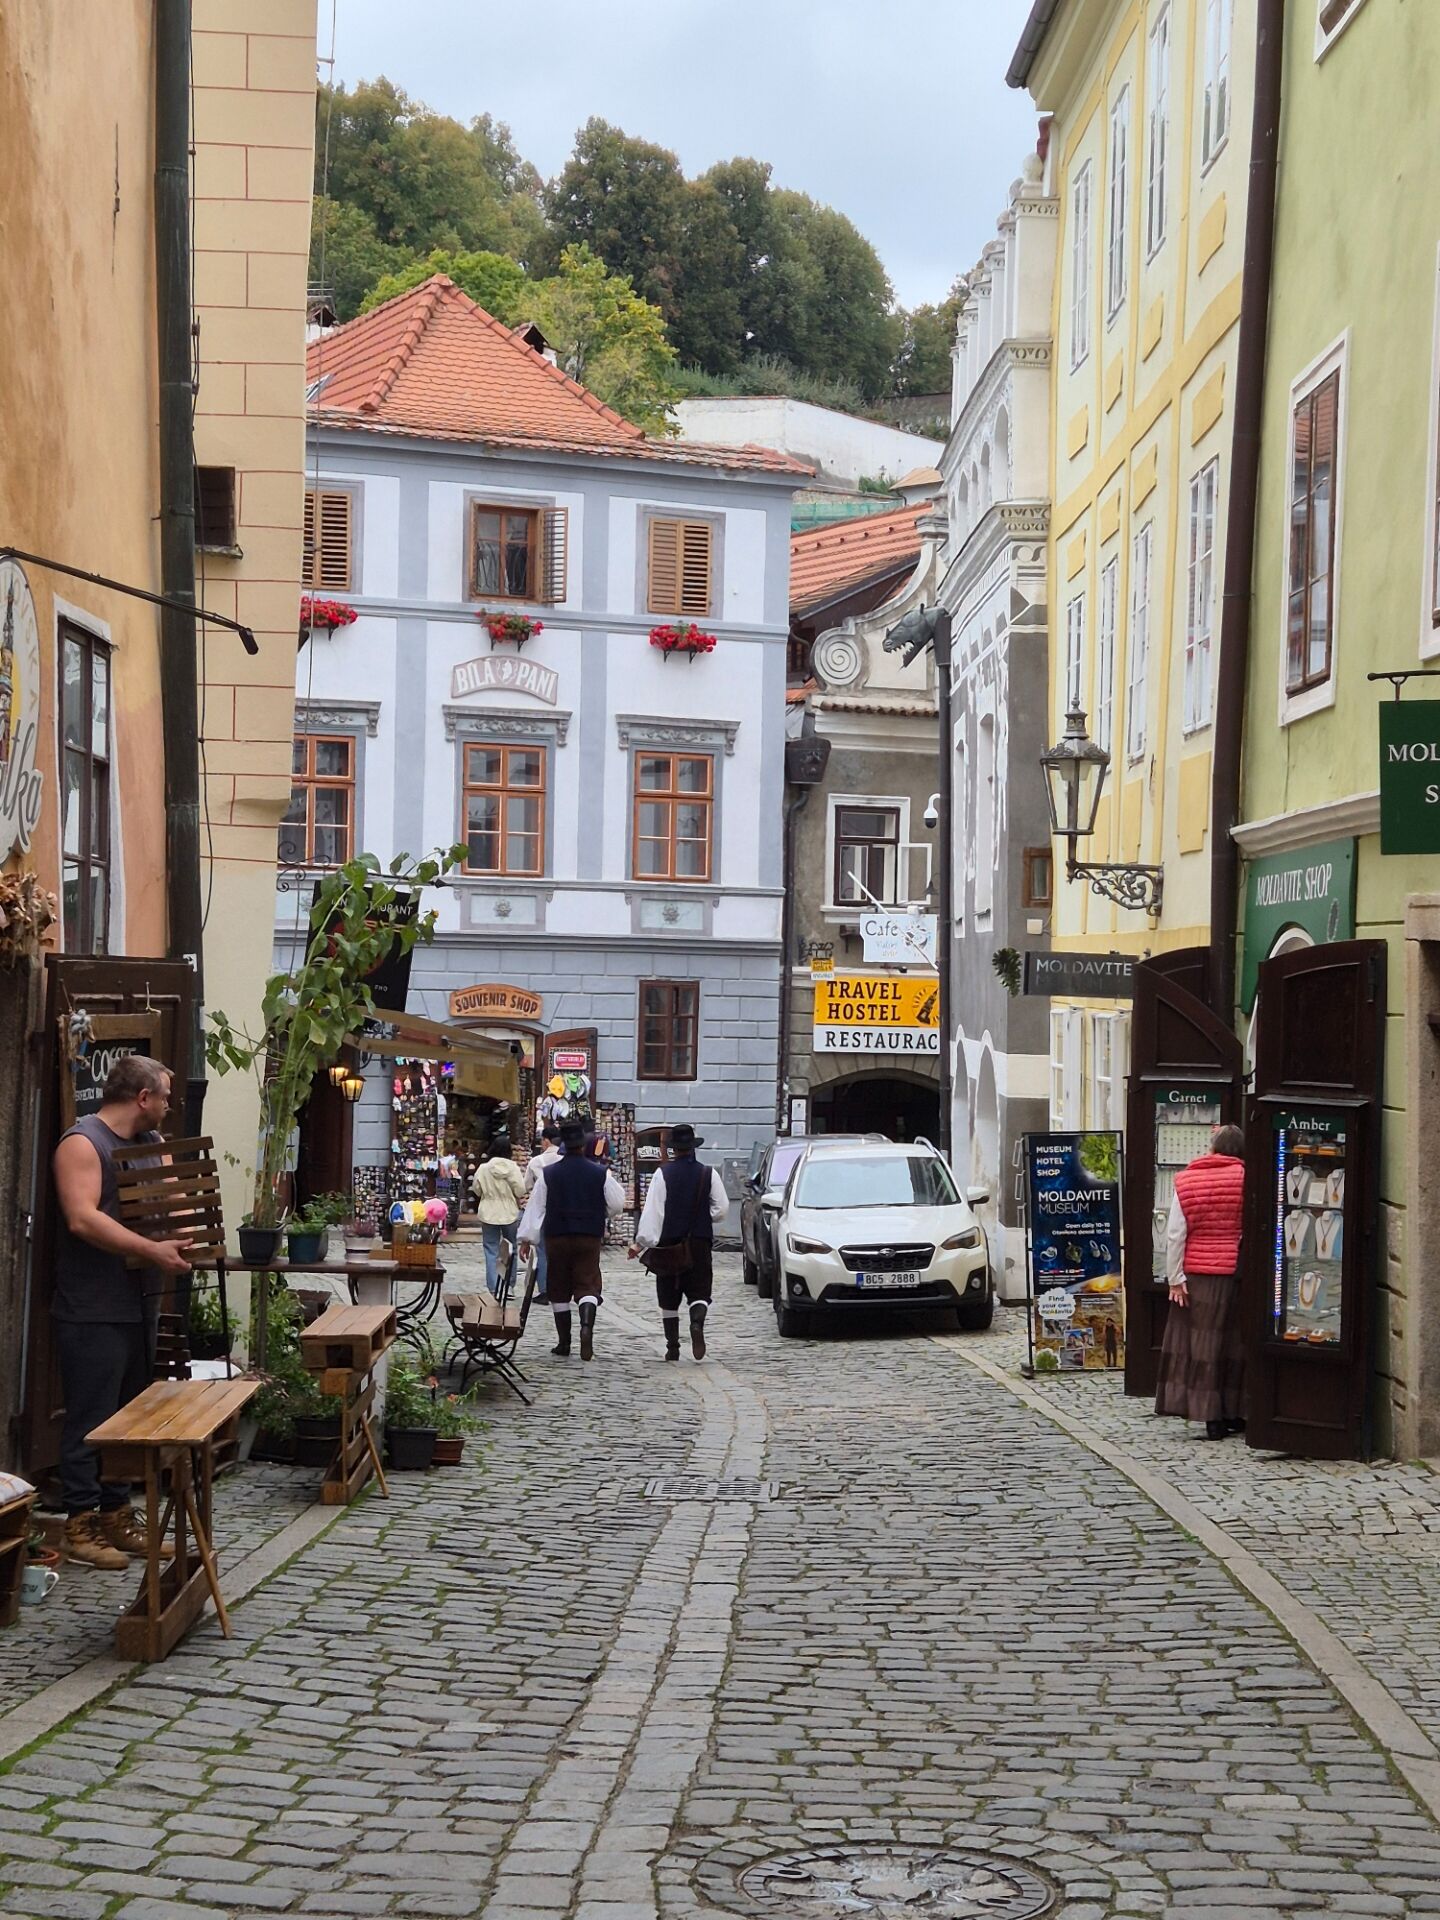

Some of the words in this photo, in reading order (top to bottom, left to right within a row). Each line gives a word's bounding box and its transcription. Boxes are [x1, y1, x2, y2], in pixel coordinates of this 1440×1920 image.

[1256, 869, 1303, 906] MOLDAVITE
[1304, 863, 1333, 901] SHOP
[1036, 959, 1132, 976] MOLDAVITE
[827, 981, 902, 1000] TRAVEL
[455, 992, 507, 1013] SOUVENIR
[510, 995, 538, 1014] SHOP
[827, 1003, 901, 1021] HOSTEL
[1168, 1090, 1207, 1103] Garnet
[1288, 1116, 1331, 1131] Amber
[1038, 1190, 1110, 1201] MOLDAVITE
[1038, 1203, 1089, 1213] MUSEUM
